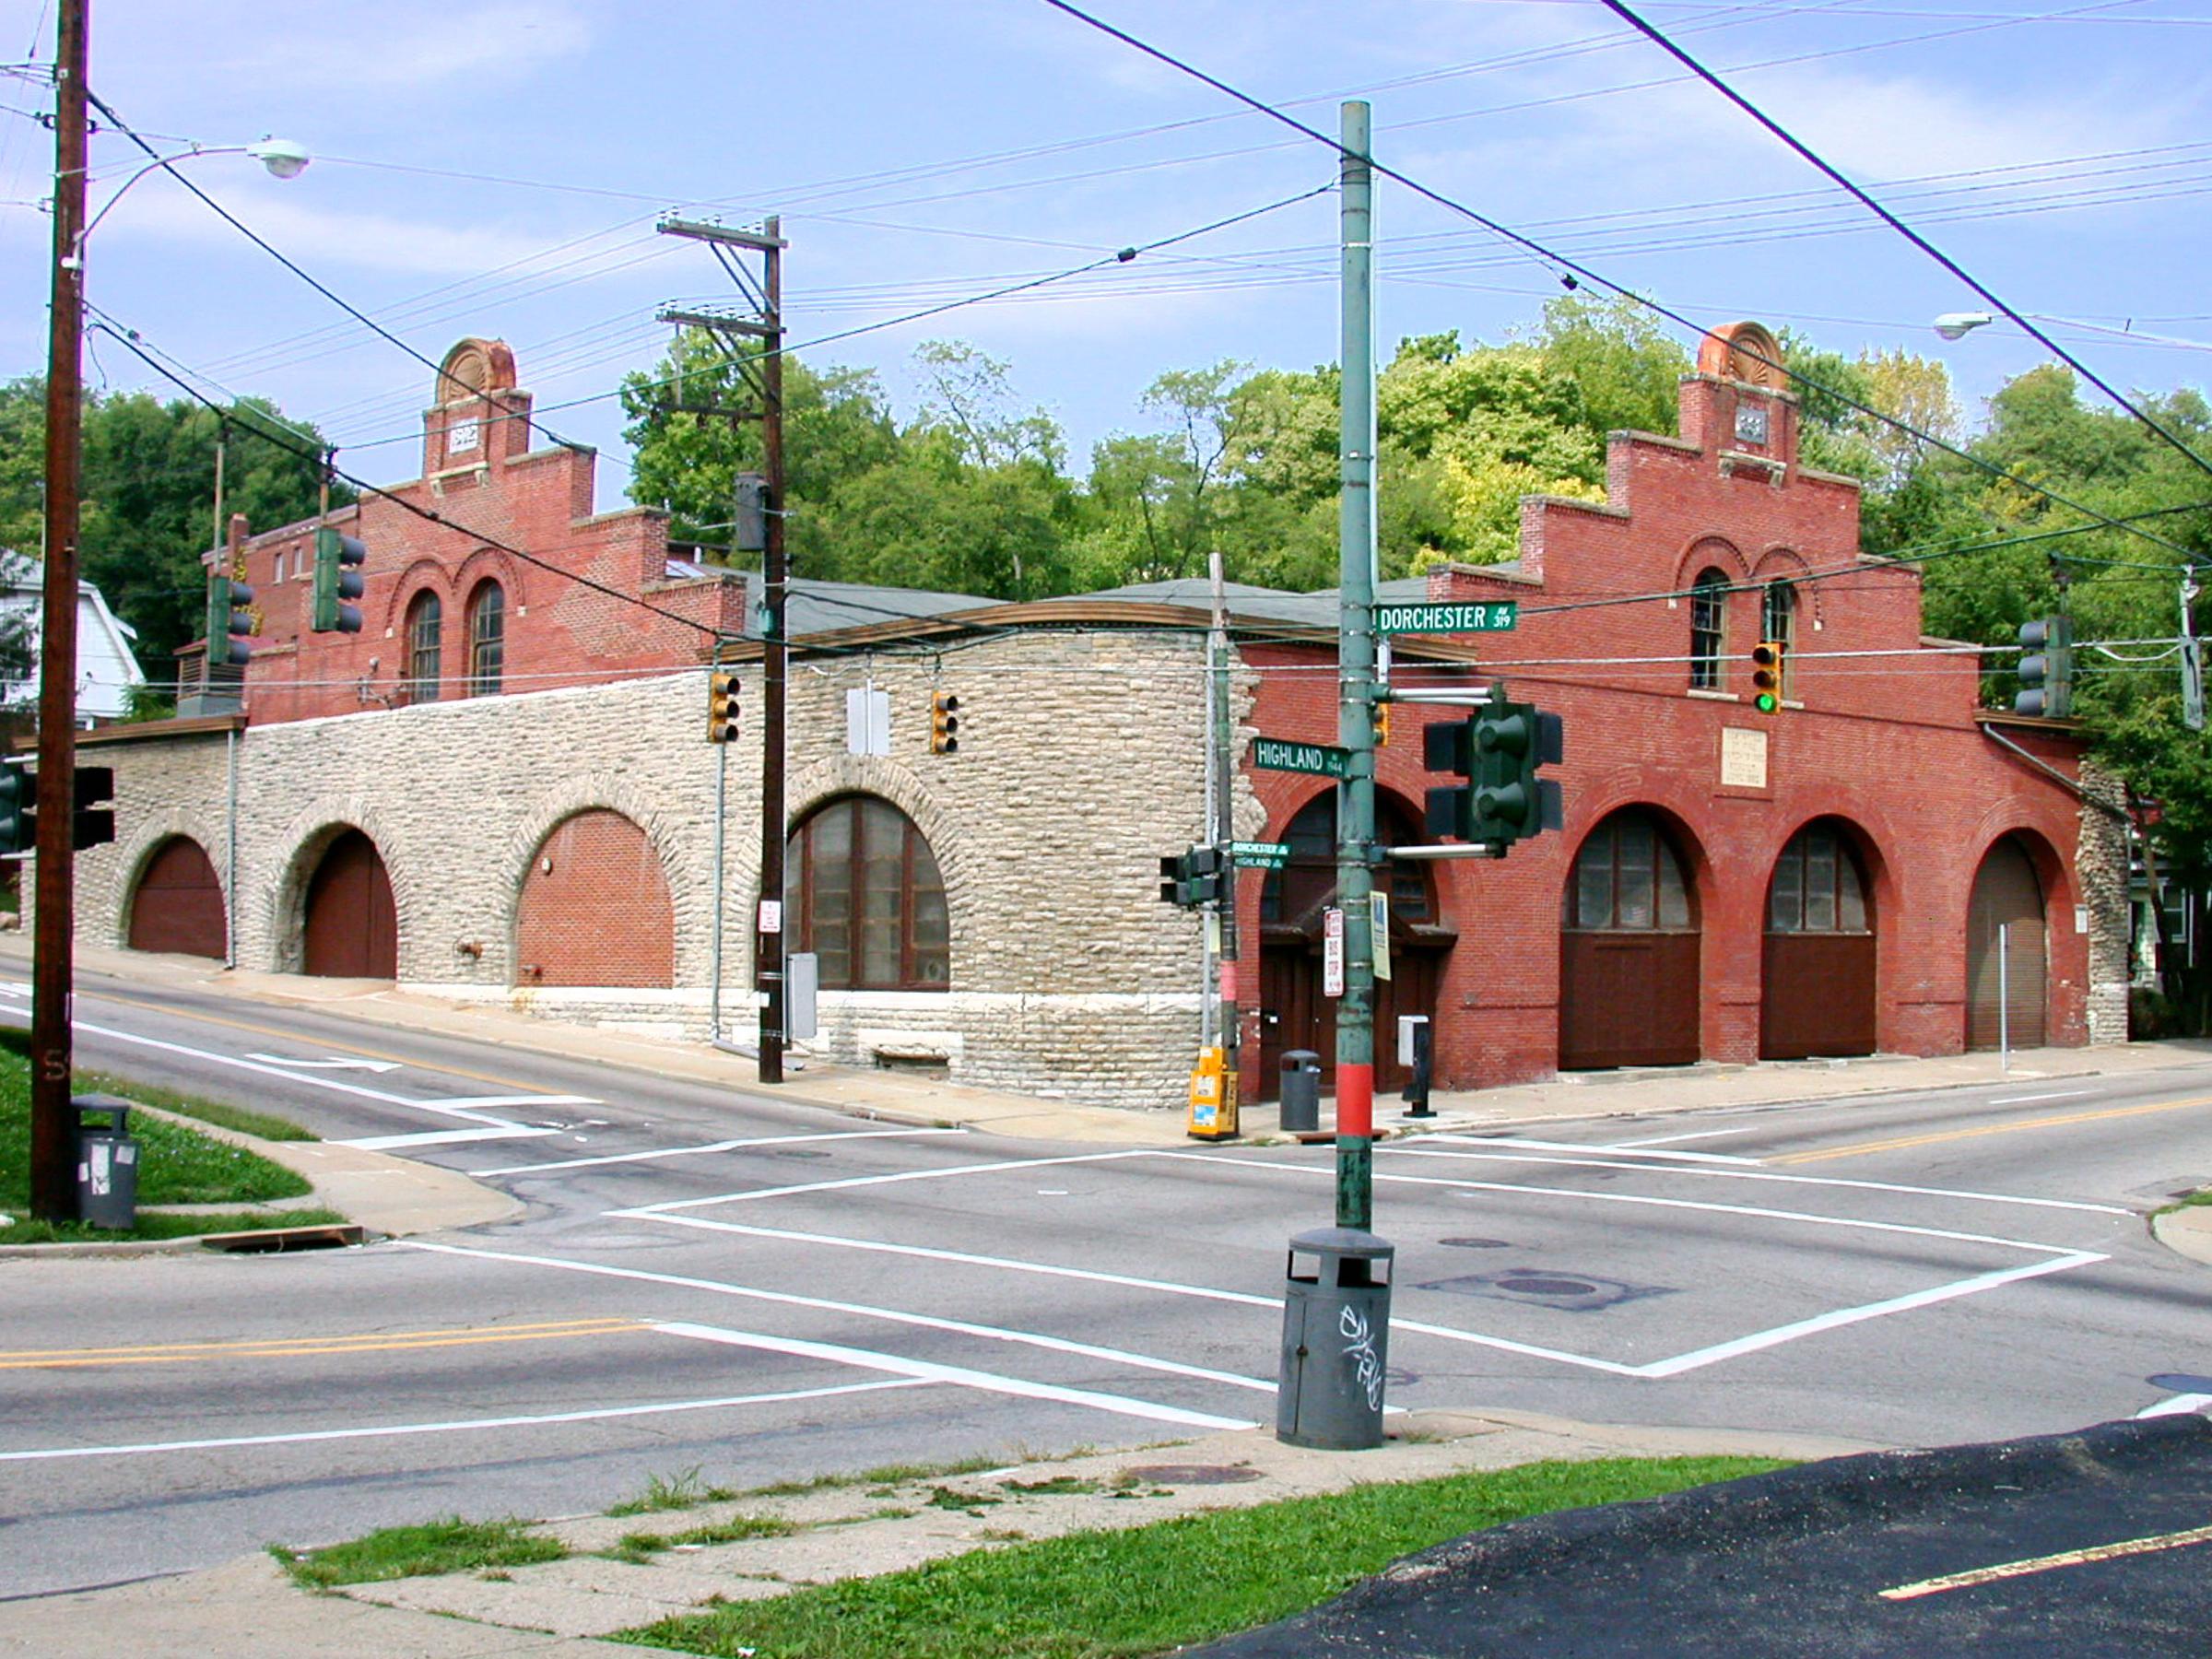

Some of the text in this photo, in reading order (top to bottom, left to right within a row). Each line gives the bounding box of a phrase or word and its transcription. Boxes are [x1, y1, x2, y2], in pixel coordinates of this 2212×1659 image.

[1381, 606, 1486, 630] DORCHESTER
[1493, 615, 1512, 628] 319
[1258, 742, 1323, 771] HIGHLAND
